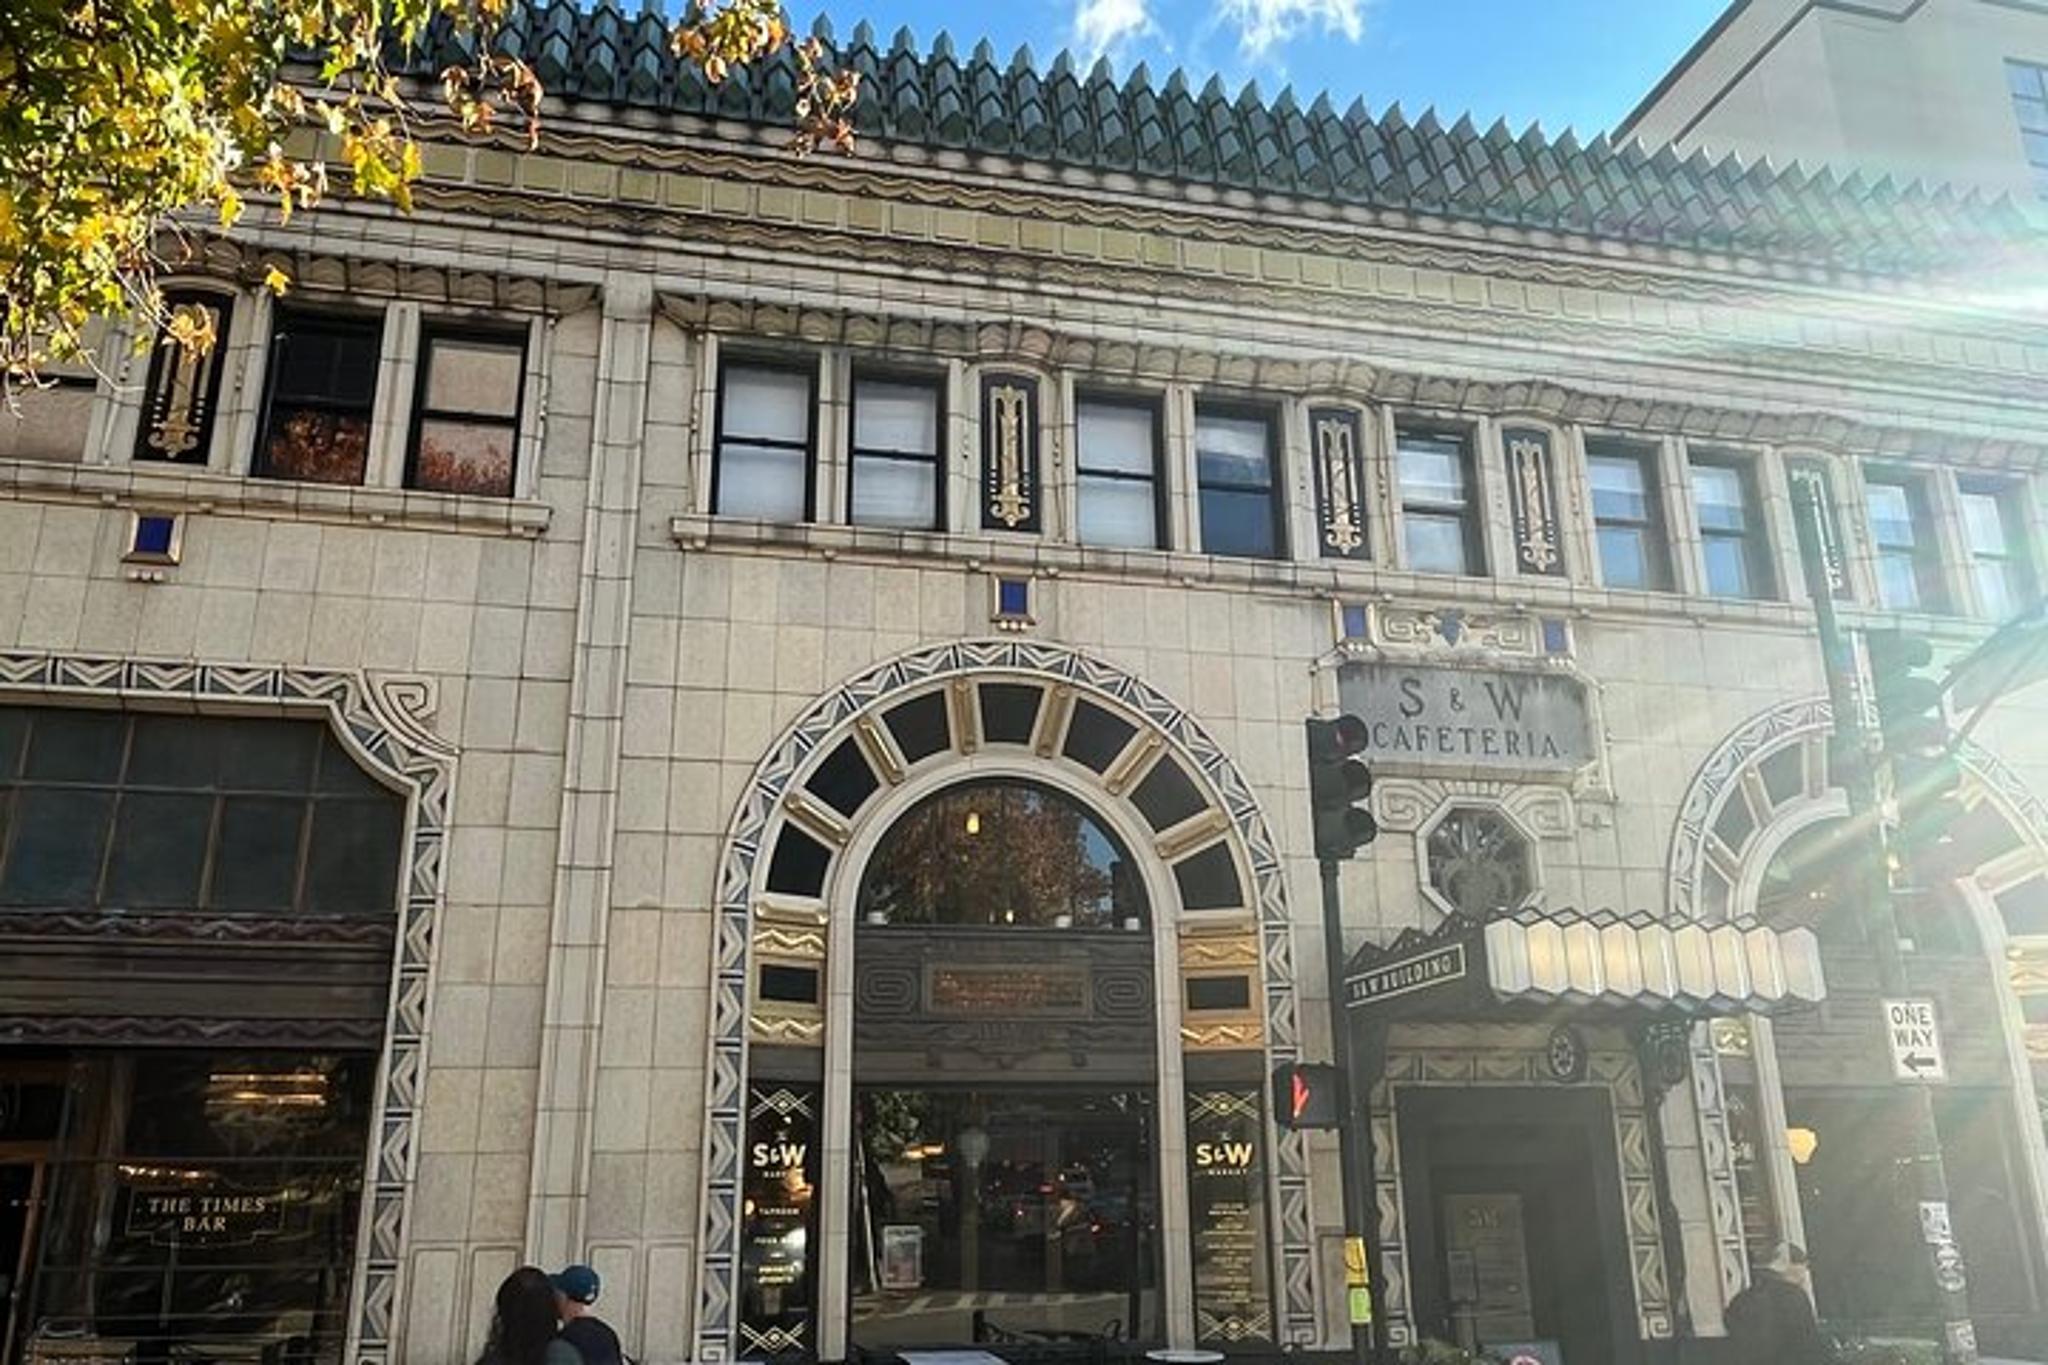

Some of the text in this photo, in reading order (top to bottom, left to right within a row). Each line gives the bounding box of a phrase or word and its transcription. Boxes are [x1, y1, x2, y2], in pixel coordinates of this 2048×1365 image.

[1399, 677, 1524, 721] S & W
[1891, 1006, 1931, 1025] ONE
[1894, 1029, 1932, 1047] WAY
[752, 1142, 807, 1167] S&W
[1196, 1142, 1252, 1167] S&W
[149, 1197, 266, 1213] THE TIMES
[183, 1216, 227, 1232] BAR
